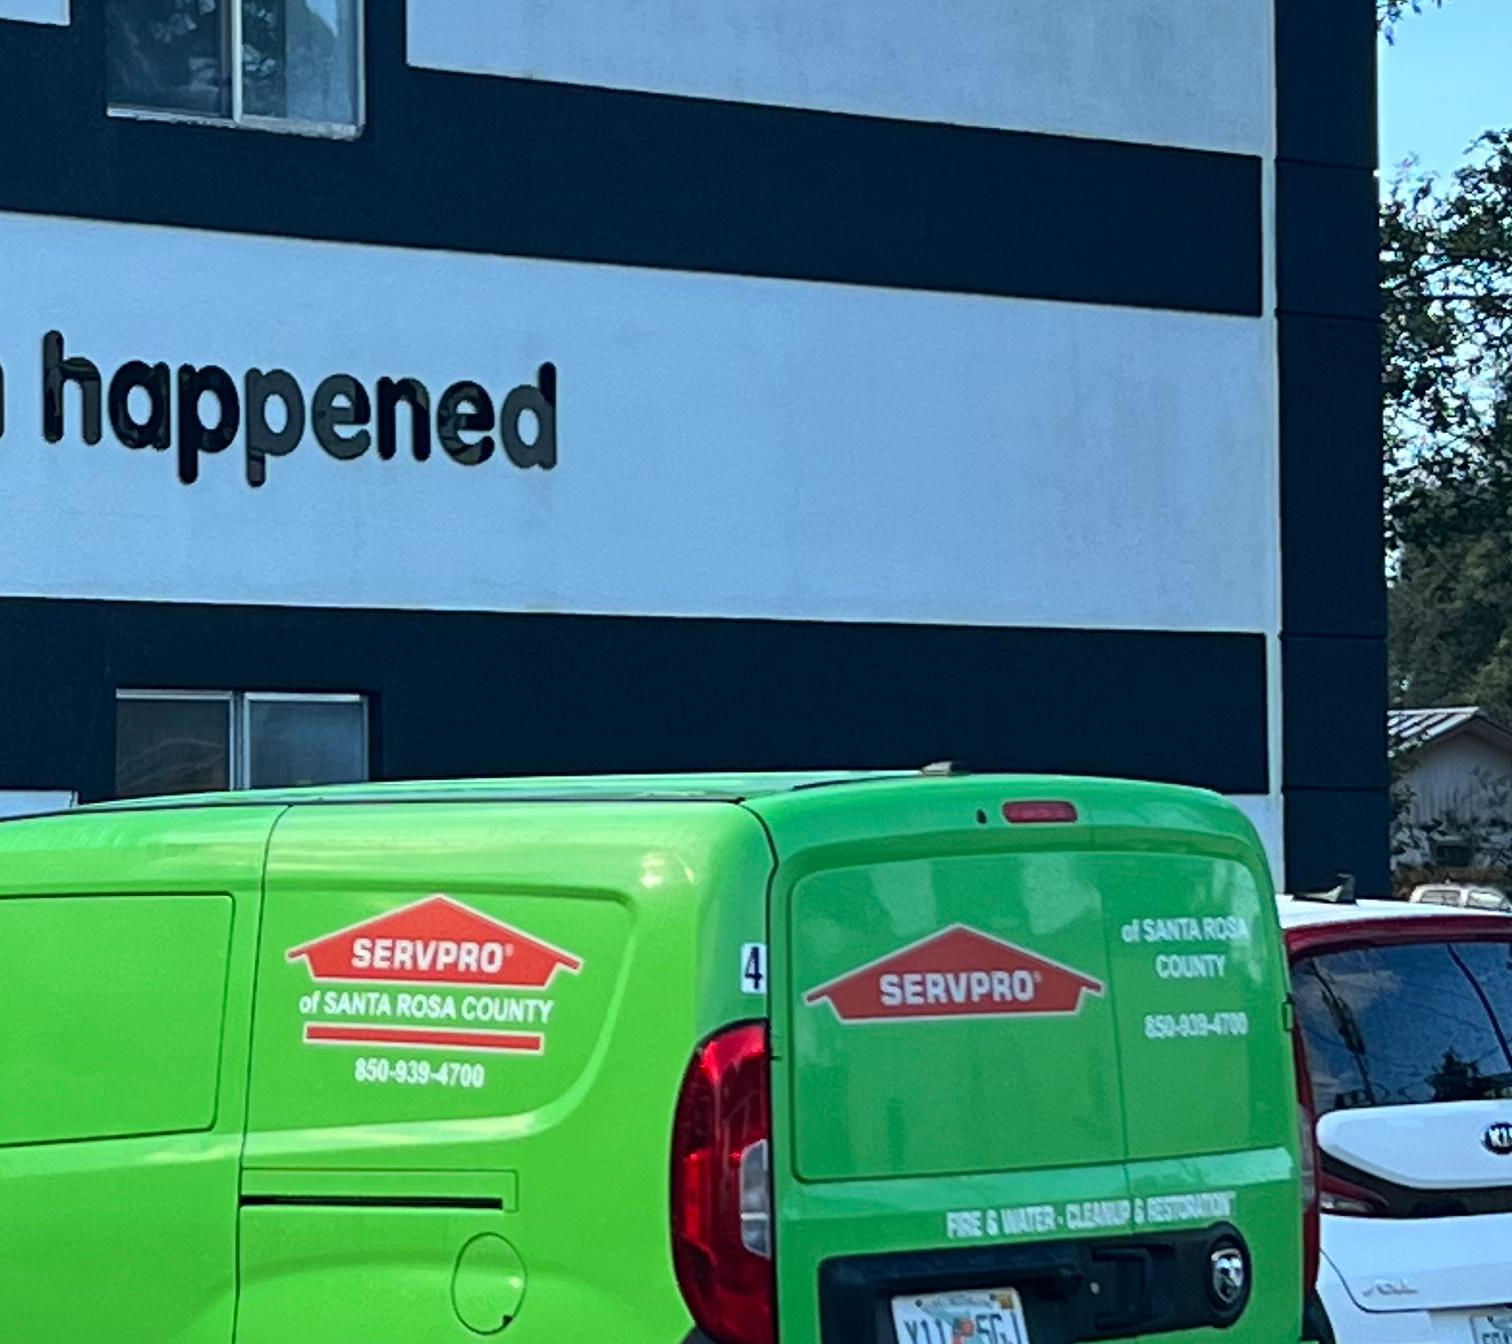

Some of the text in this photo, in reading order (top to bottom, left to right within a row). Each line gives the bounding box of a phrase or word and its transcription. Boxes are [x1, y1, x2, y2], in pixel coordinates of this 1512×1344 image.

[42, 330, 557, 487] happened
[1121, 915, 1251, 943] of SANTA ROSA
[744, 945, 763, 989] 4
[1155, 954, 1227, 978] COUNTY
[299, 990, 554, 1023] of SANTA ROSA COUNTY
[1144, 1011, 1249, 1039] 850-939-4700
[354, 1057, 485, 1088] 850-939-4700
[946, 1210, 983, 1238] FIRE
[986, 1209, 999, 1236] &
[1000, 1205, 1057, 1235] WATER
[1066, 1199, 1131, 1230] CLEANUP
[1134, 1198, 1144, 1224] &
